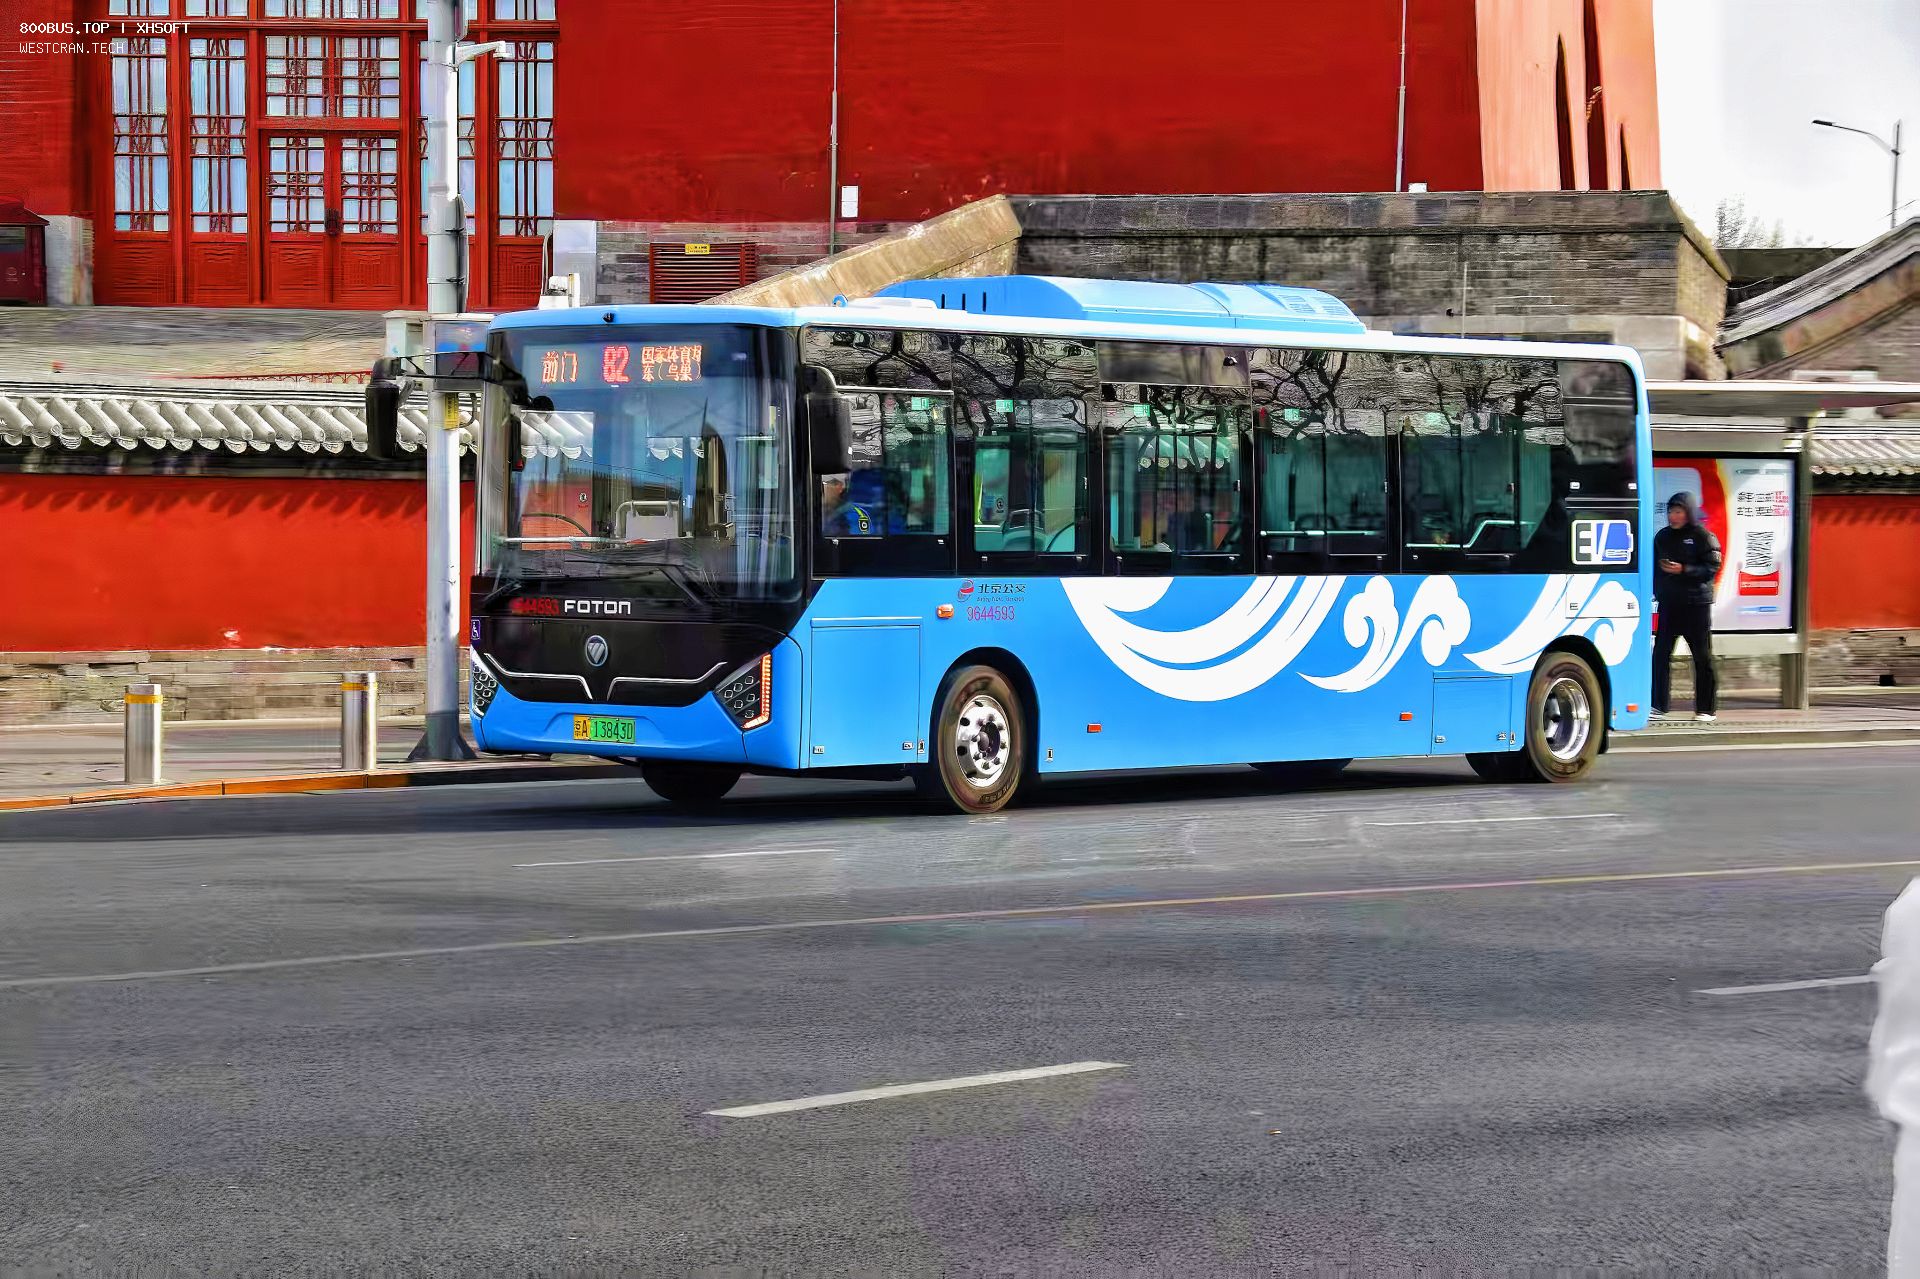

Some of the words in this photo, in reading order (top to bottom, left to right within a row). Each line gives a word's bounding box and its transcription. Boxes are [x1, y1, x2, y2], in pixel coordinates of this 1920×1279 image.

[541, 351, 578, 383] 前门
[603, 346, 631, 383] 82
[978, 583, 1026, 594] 北京公交
[564, 599, 631, 615] FOTON
[966, 605, 1015, 621] 9644593
